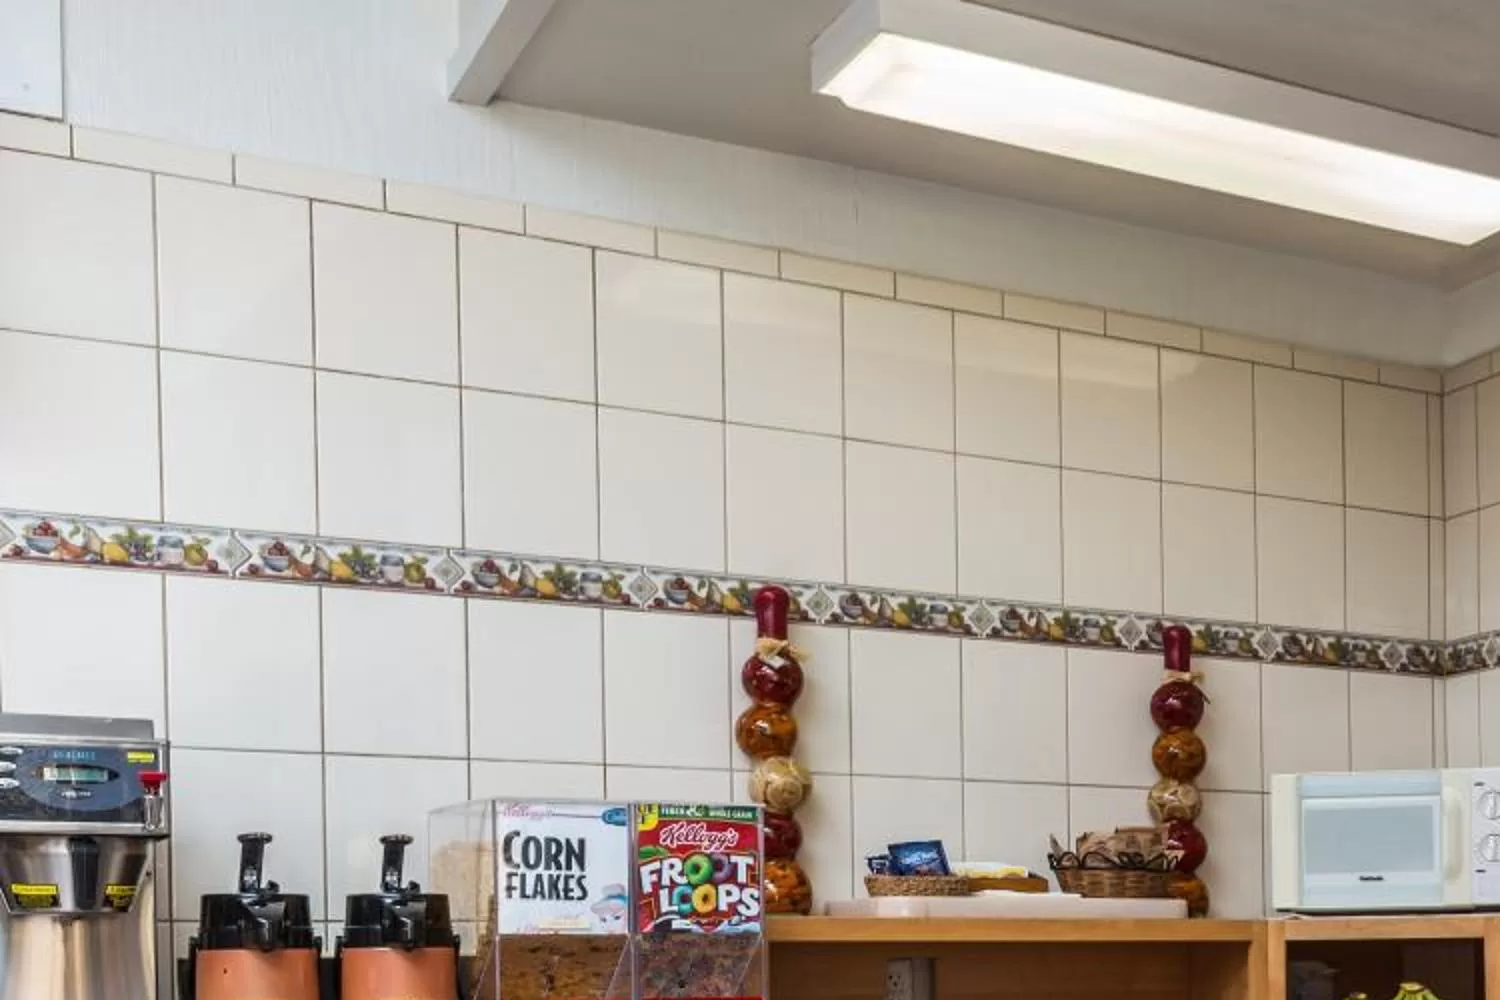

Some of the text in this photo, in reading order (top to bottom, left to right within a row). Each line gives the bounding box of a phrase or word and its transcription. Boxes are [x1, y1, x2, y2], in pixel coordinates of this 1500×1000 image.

[502, 830, 586, 872] CORN
[660, 821, 739, 851] Kellogg's
[505, 871, 589, 901] FLAKES
[640, 851, 756, 895] FROOT
[659, 883, 760, 917] LOOPS
